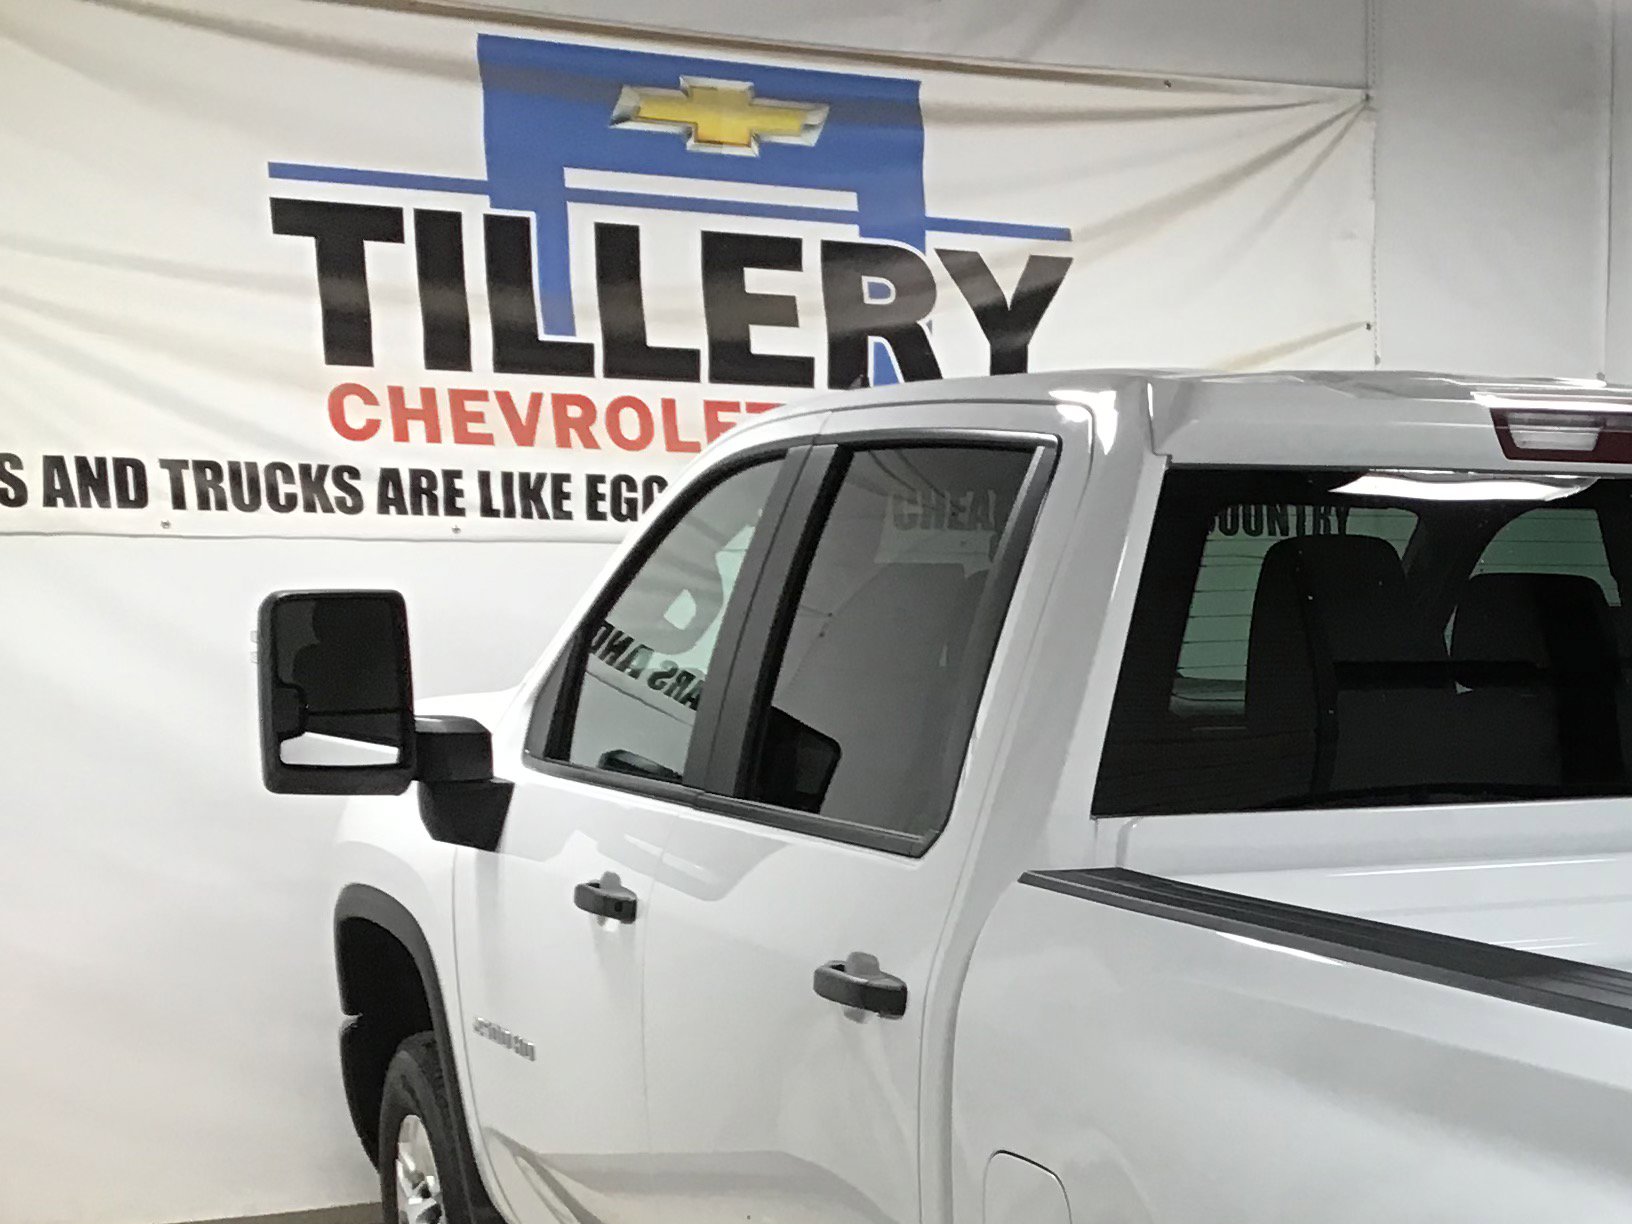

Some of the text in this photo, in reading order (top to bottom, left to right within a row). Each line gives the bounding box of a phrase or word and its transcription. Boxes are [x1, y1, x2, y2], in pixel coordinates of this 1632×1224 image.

[268, 196, 1074, 390] TILLERY
[42, 456, 149, 510] AND
[158, 458, 362, 516] TRUCKS
[376, 467, 467, 518] ARE
[478, 470, 573, 521] LIKE
[1203, 503, 1350, 536] OUNTRY
